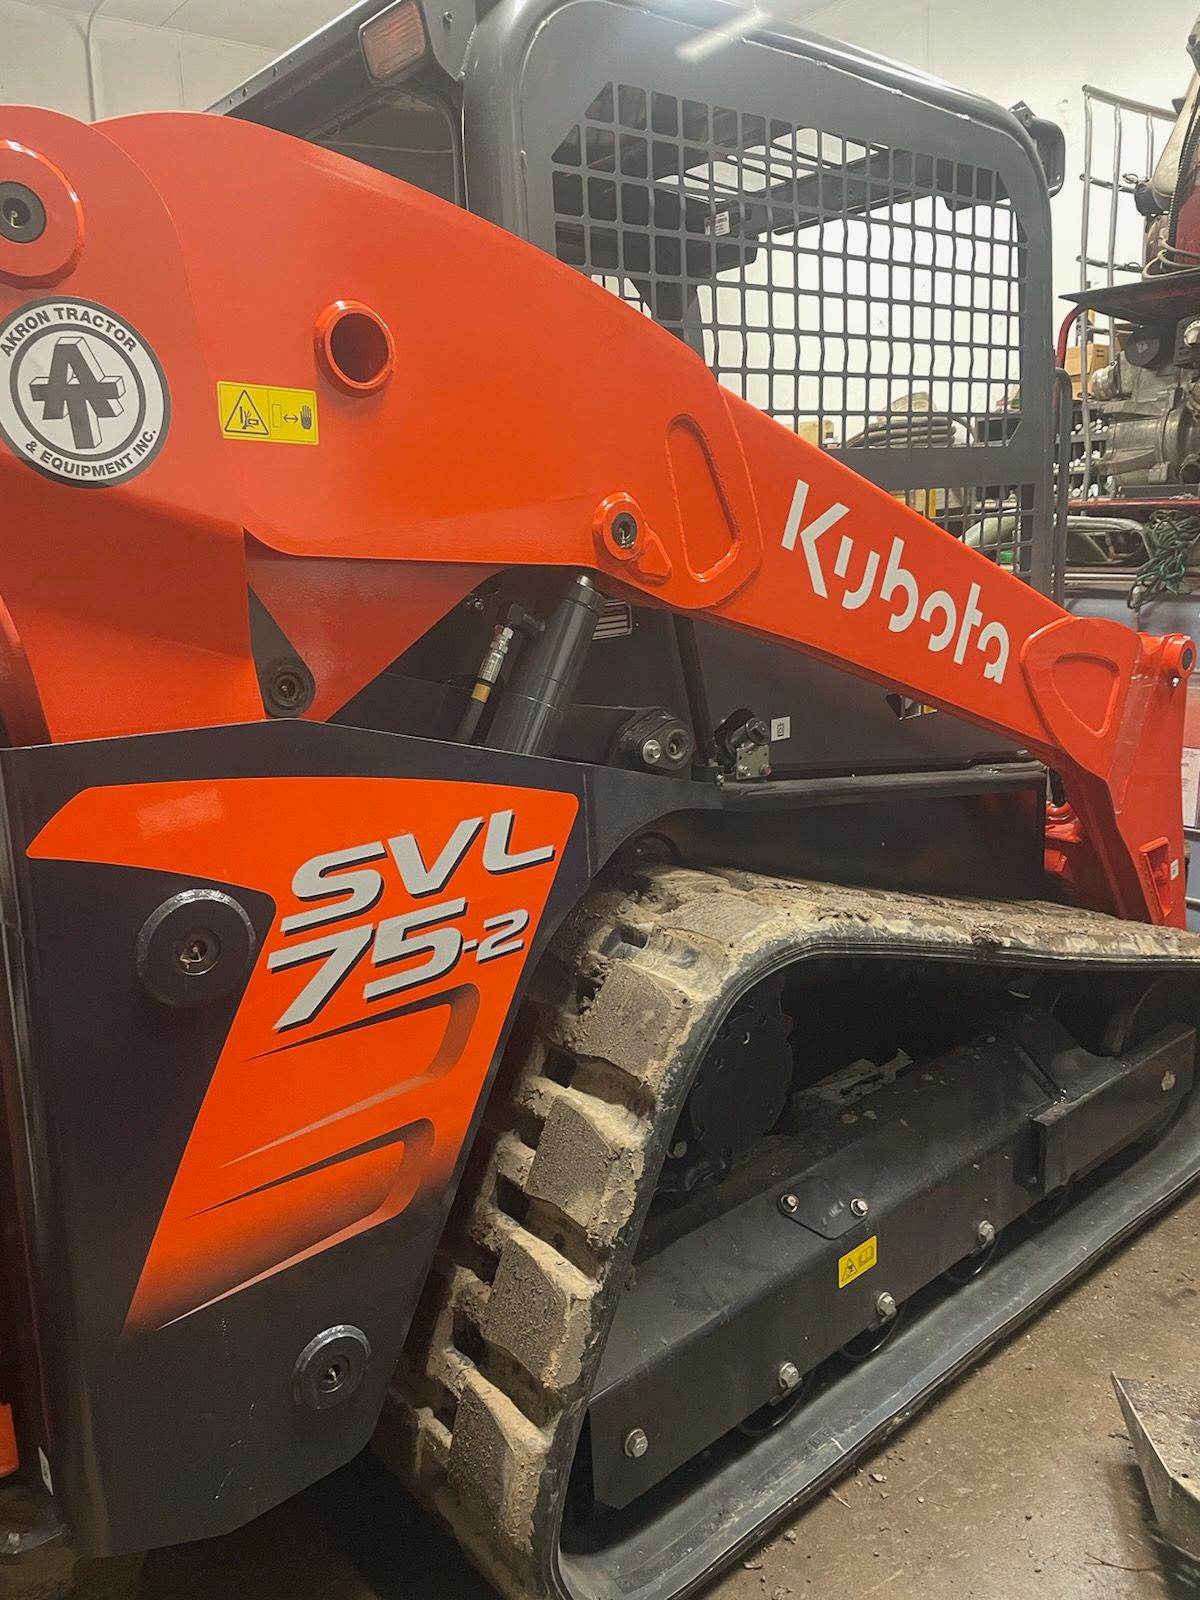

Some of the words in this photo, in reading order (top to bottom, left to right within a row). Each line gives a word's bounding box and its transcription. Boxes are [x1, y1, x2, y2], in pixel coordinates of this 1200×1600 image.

[0, 309, 51, 357] AKRON
[53, 307, 138, 353] TRACTOR
[26, 440, 38, 453] &
[41, 452, 133, 476] EQUIPMENT
[132, 428, 157, 457] INC.
[781, 479, 1010, 685] Kubota
[280, 809, 555, 936] SVL
[266, 897, 530, 1034] 75-2
